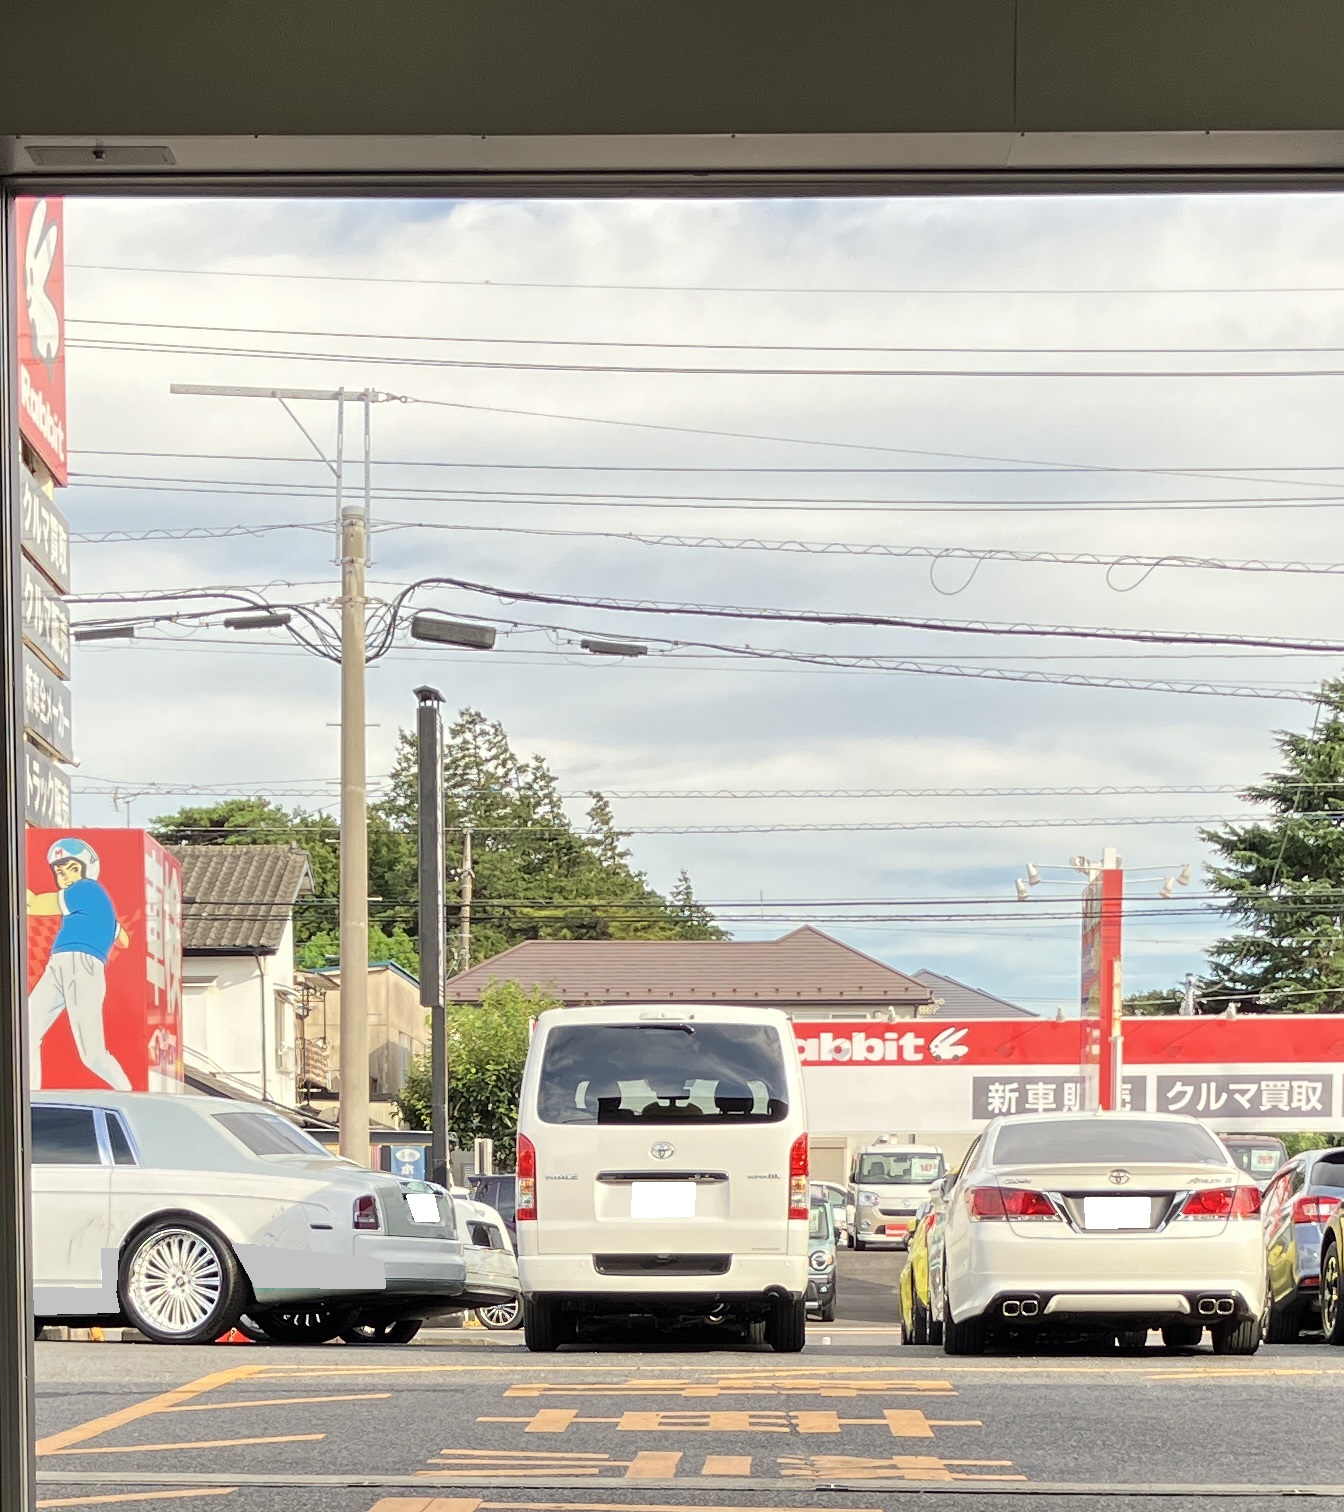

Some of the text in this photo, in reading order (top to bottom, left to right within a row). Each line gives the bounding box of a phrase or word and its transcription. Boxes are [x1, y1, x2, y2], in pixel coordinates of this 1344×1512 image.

[20, 363, 65, 463] Rabbit
[24, 481, 68, 577] クルマ買取
[795, 1032, 925, 1062] abbit
[1166, 1080, 1323, 1112] クルマ買取
